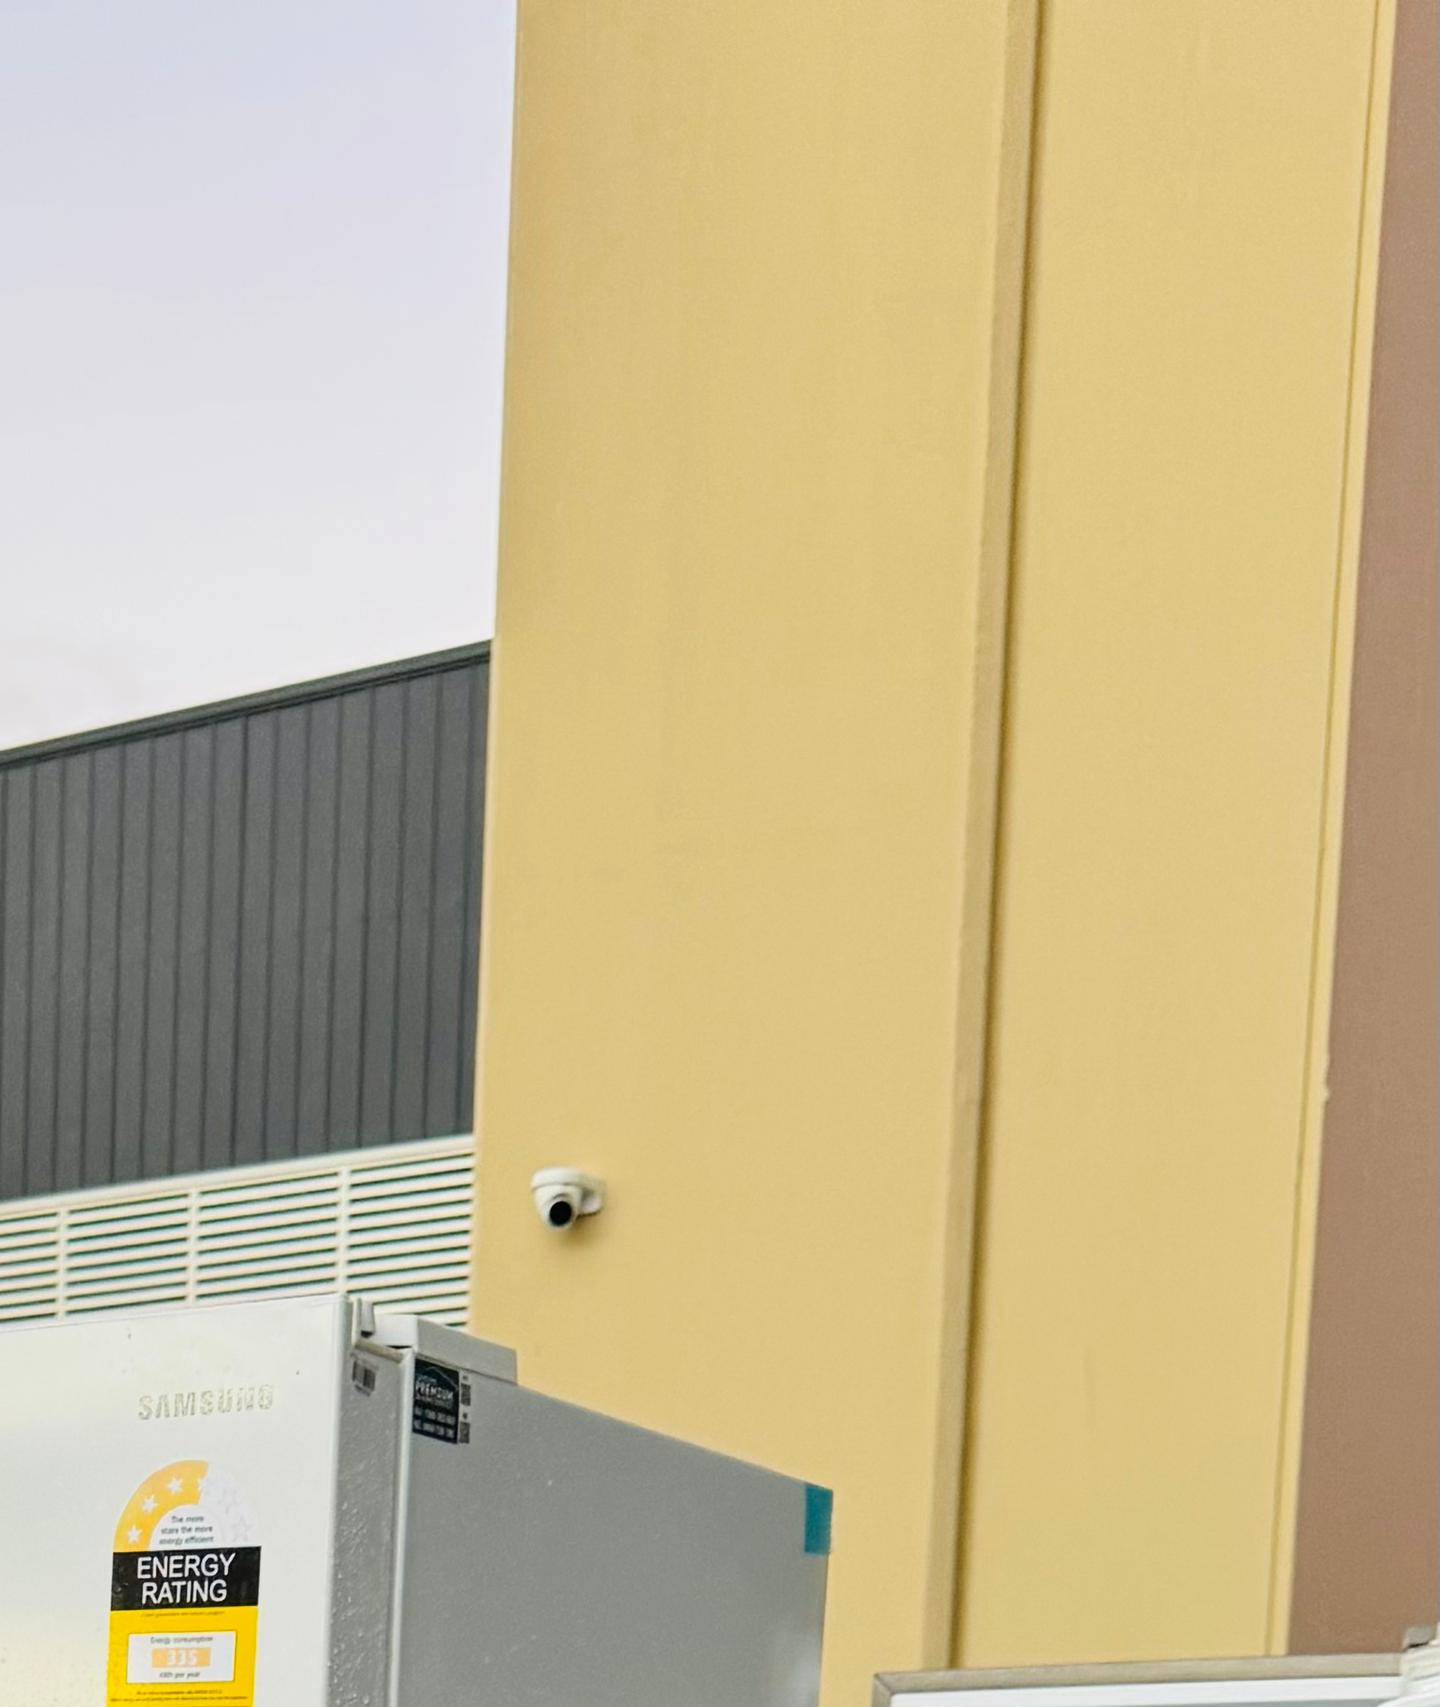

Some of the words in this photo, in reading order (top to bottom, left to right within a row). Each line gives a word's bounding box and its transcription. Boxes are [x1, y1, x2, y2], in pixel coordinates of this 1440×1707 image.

[138, 1384, 273, 1420] SAMSUNG
[137, 1552, 236, 1579] ENERGY
[141, 1578, 228, 1605] RATING
